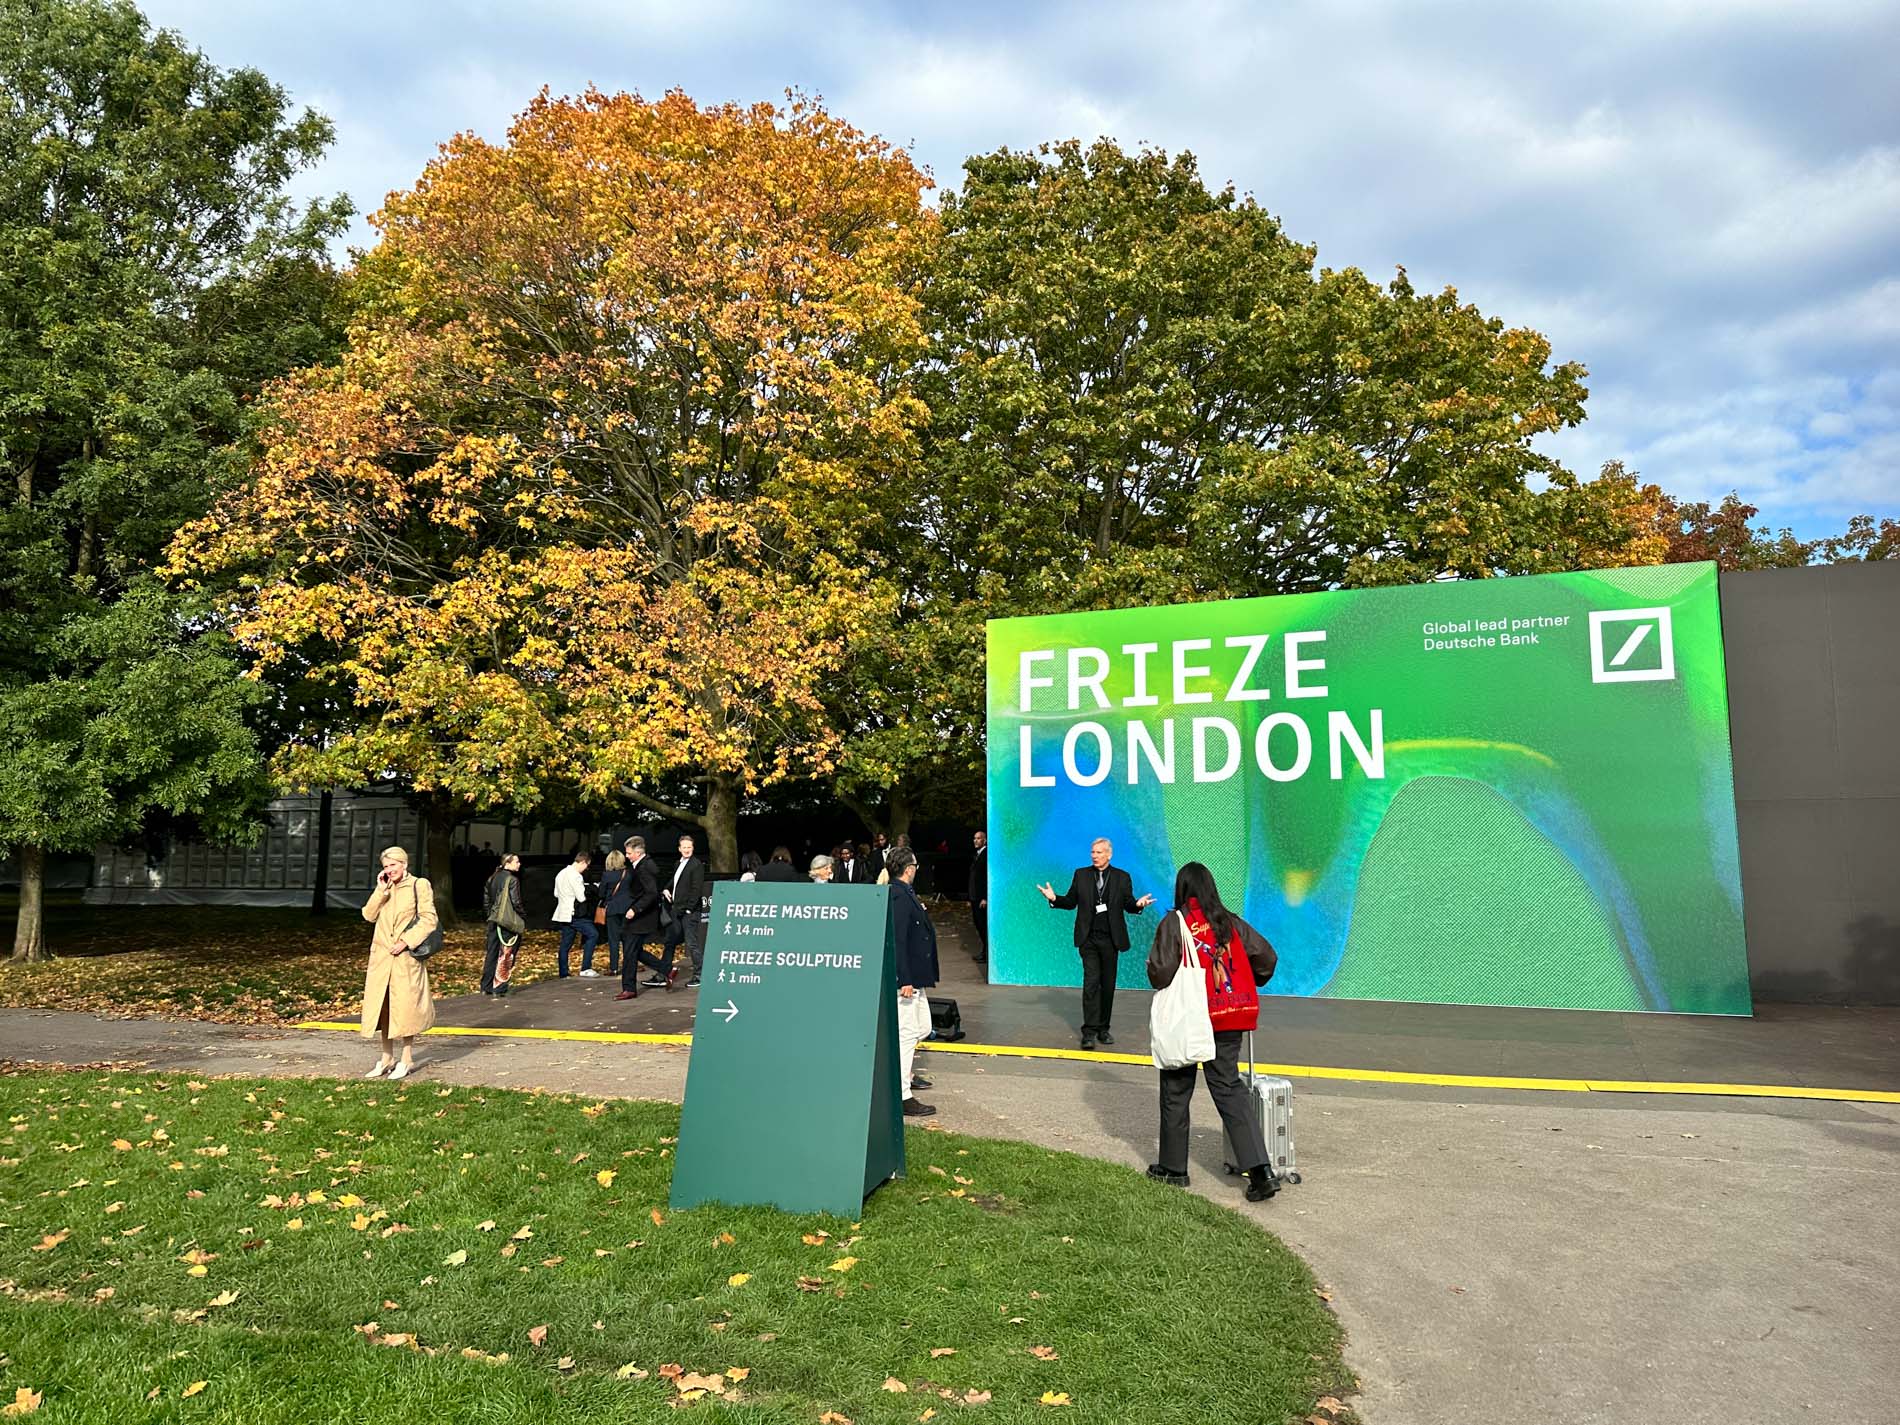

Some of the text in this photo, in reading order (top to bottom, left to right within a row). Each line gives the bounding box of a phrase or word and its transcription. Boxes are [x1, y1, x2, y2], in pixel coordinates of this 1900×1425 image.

[1423, 615, 1570, 635] Global lead partner
[1424, 632, 1539, 651] Deutsche Bank
[1019, 630, 1329, 713] FRIEZE
[1019, 709, 1386, 788] LONDON
[726, 903, 778, 918] FRIEZE
[781, 904, 849, 920] MASTERS
[735, 924, 775, 936] 14 min
[720, 950, 863, 969] FRIEZE SCULPTURE
[729, 971, 761, 984] 1 min
